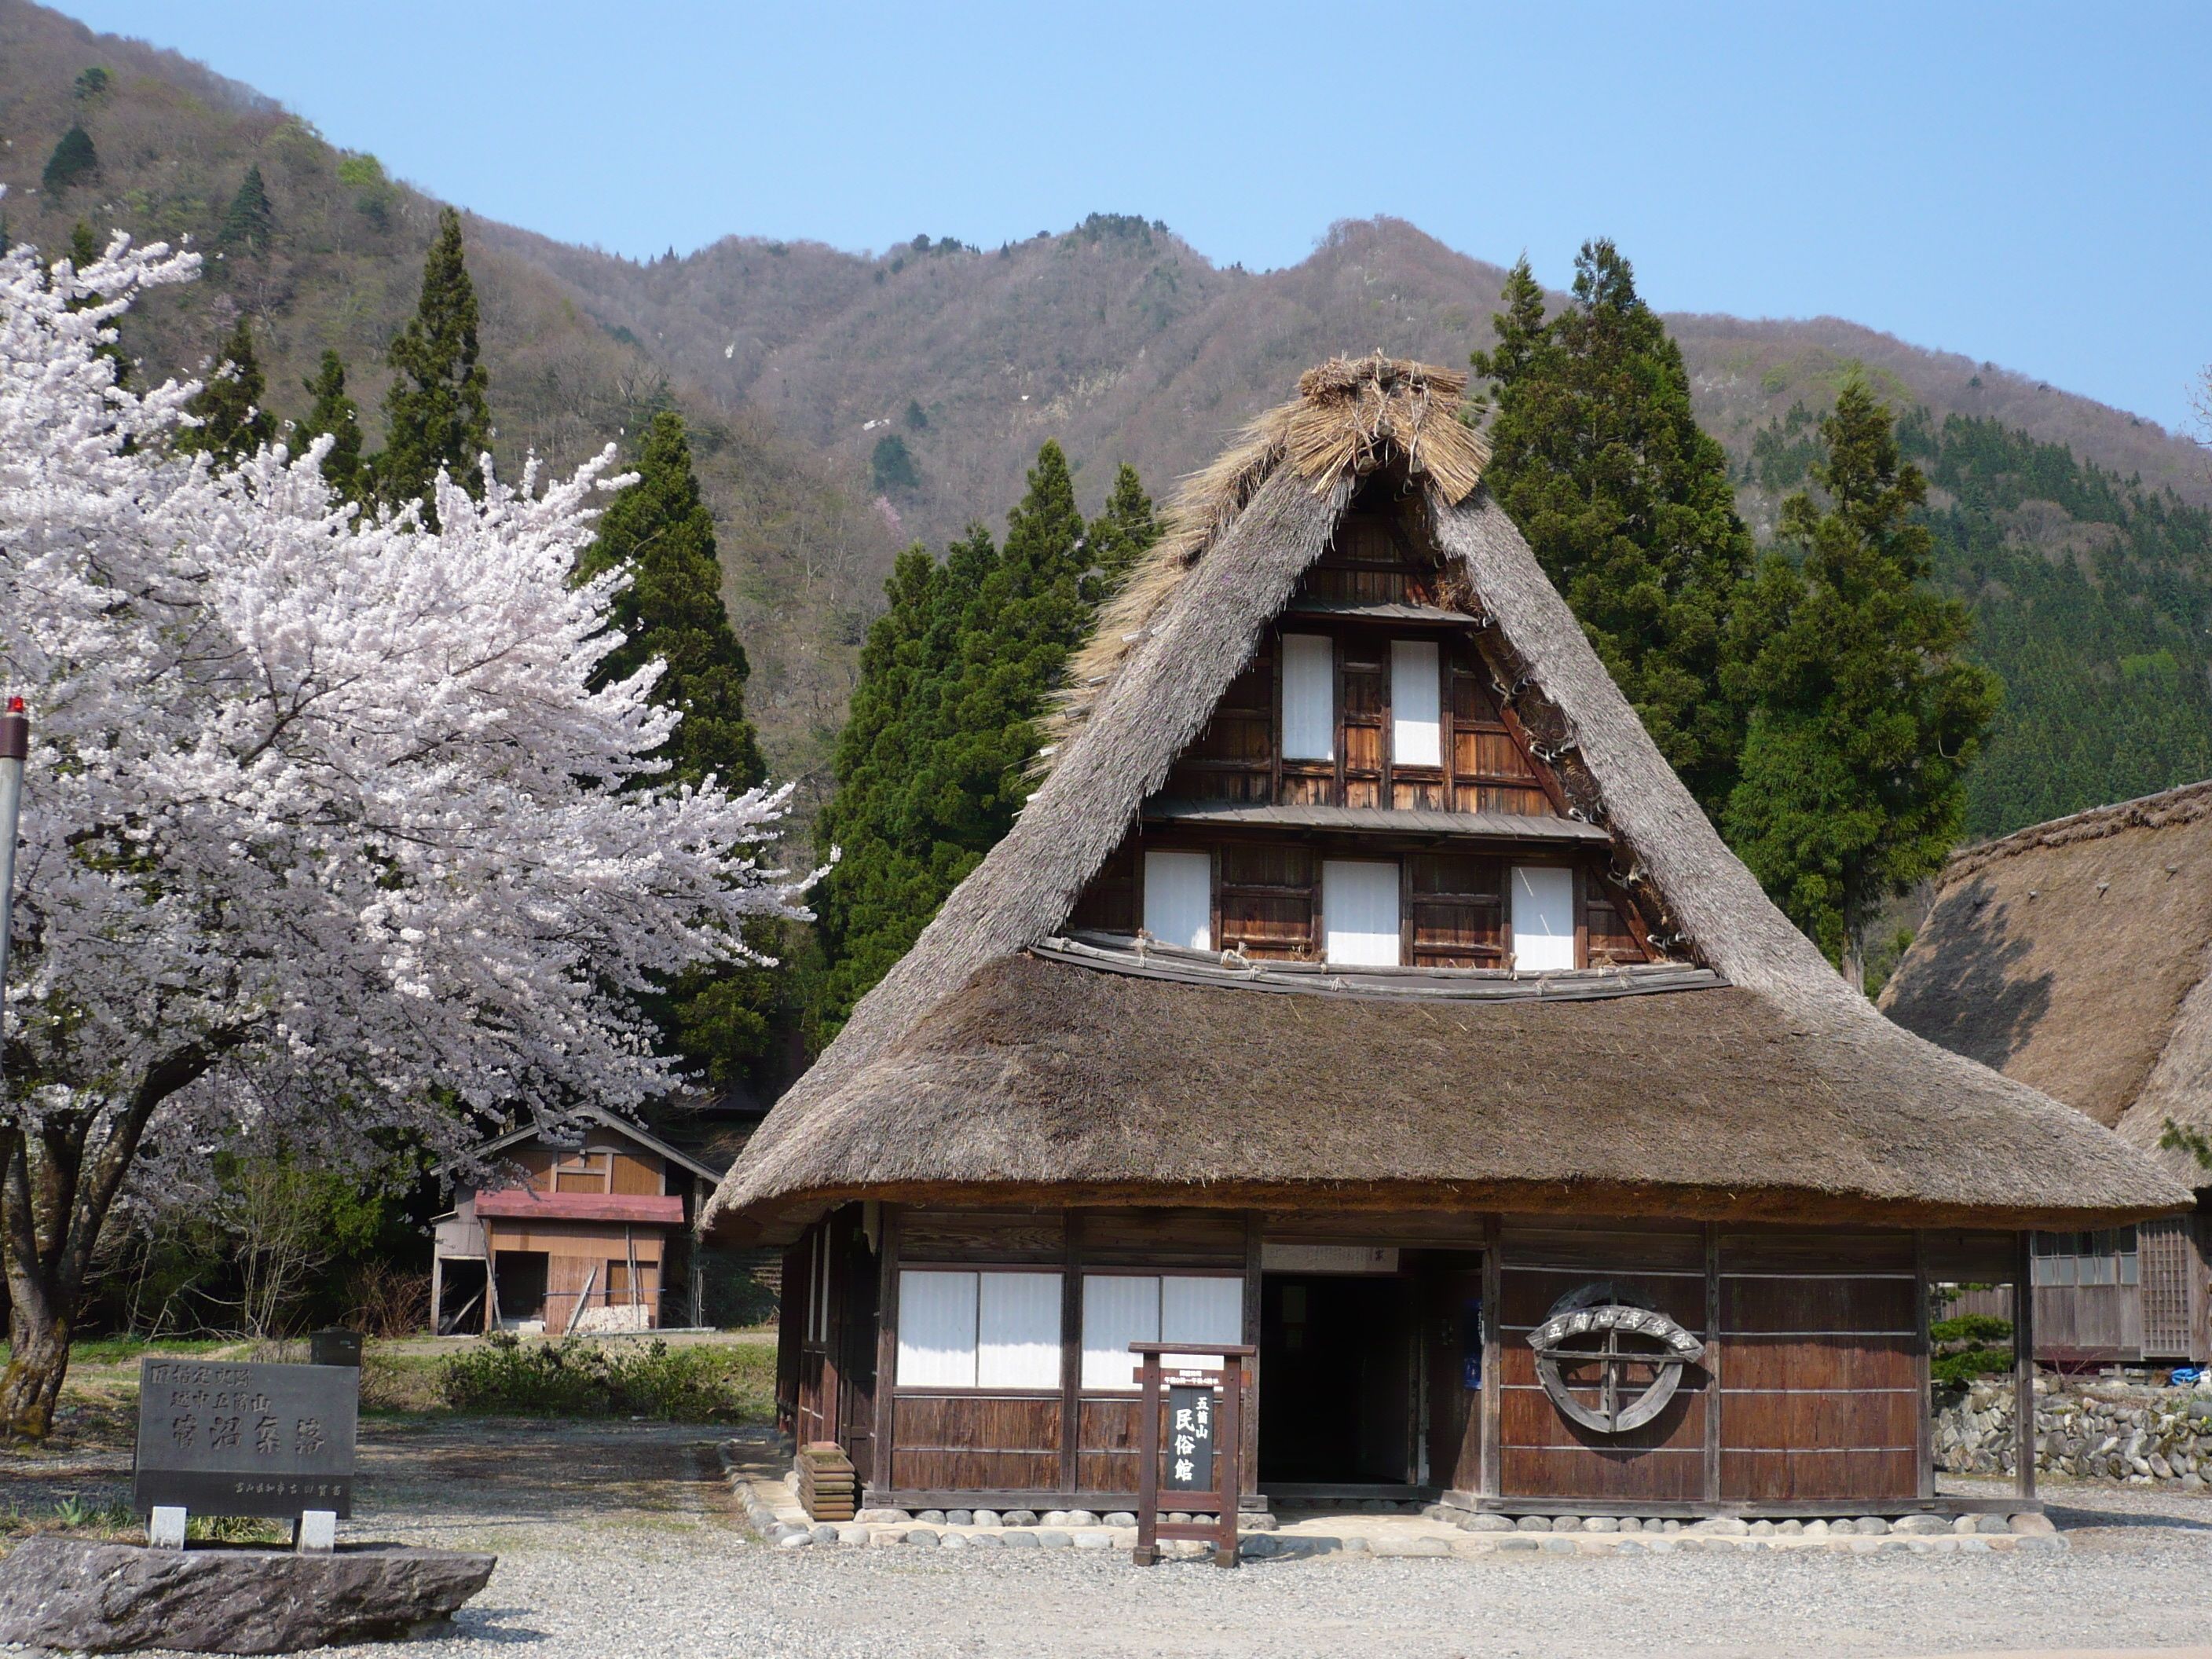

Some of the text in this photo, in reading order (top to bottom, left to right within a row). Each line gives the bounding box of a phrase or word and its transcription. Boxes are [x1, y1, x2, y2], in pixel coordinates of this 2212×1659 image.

[1175, 1409, 1196, 1481] 民俗館
[1196, 1397, 1209, 1439] 五箇山
